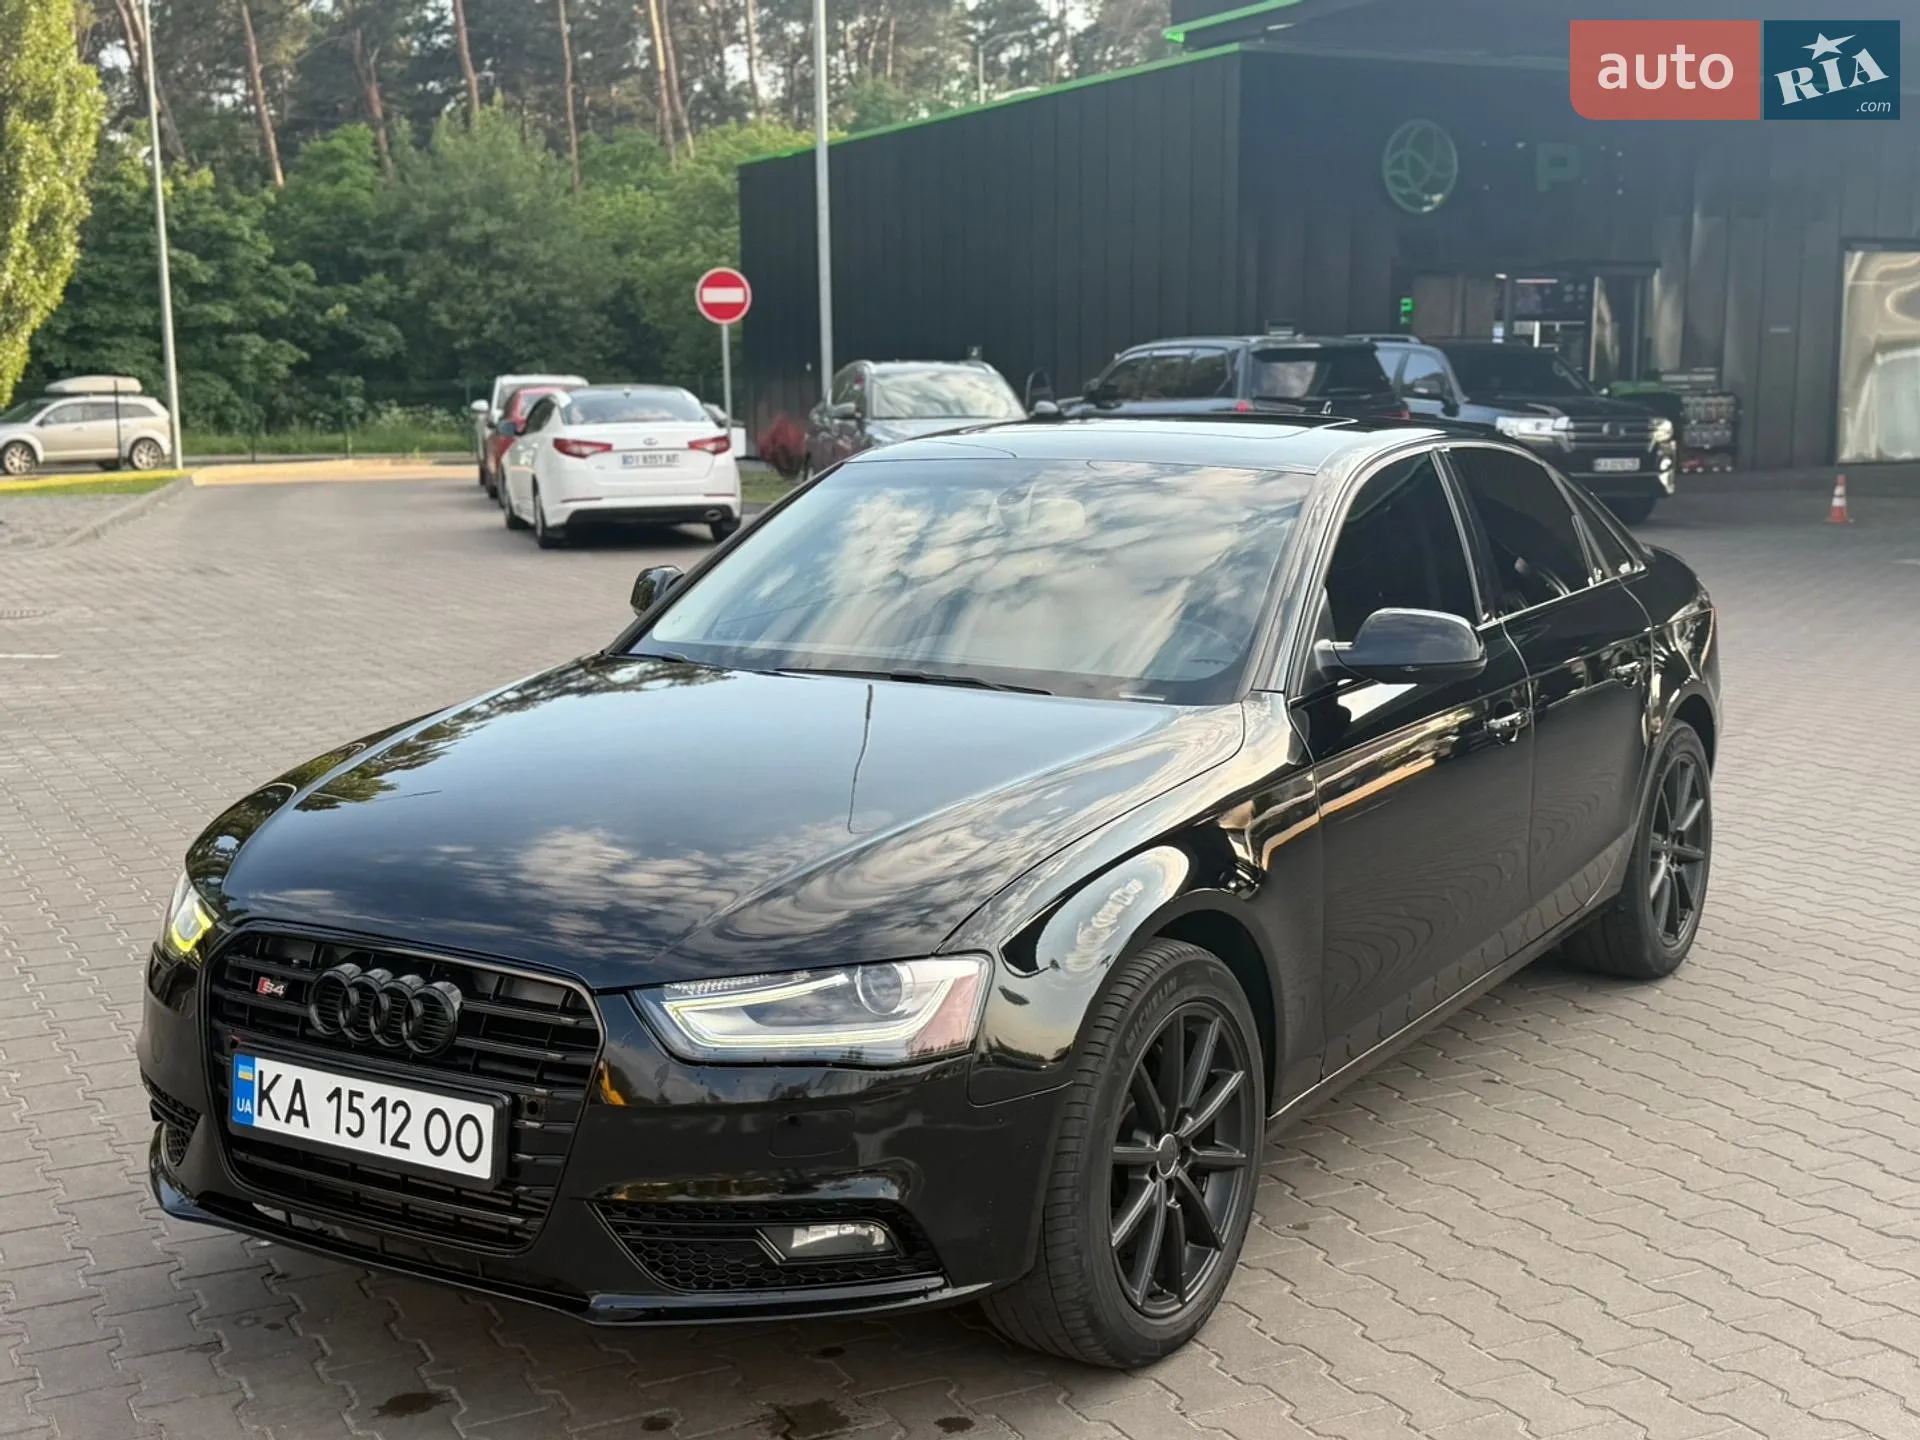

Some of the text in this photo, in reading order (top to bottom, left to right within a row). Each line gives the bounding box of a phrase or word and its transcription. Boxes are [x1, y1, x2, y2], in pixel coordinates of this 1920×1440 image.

[236, 1098, 252, 1115] UA
[257, 1069, 310, 1129] KA
[326, 1086, 411, 1151] 1512
